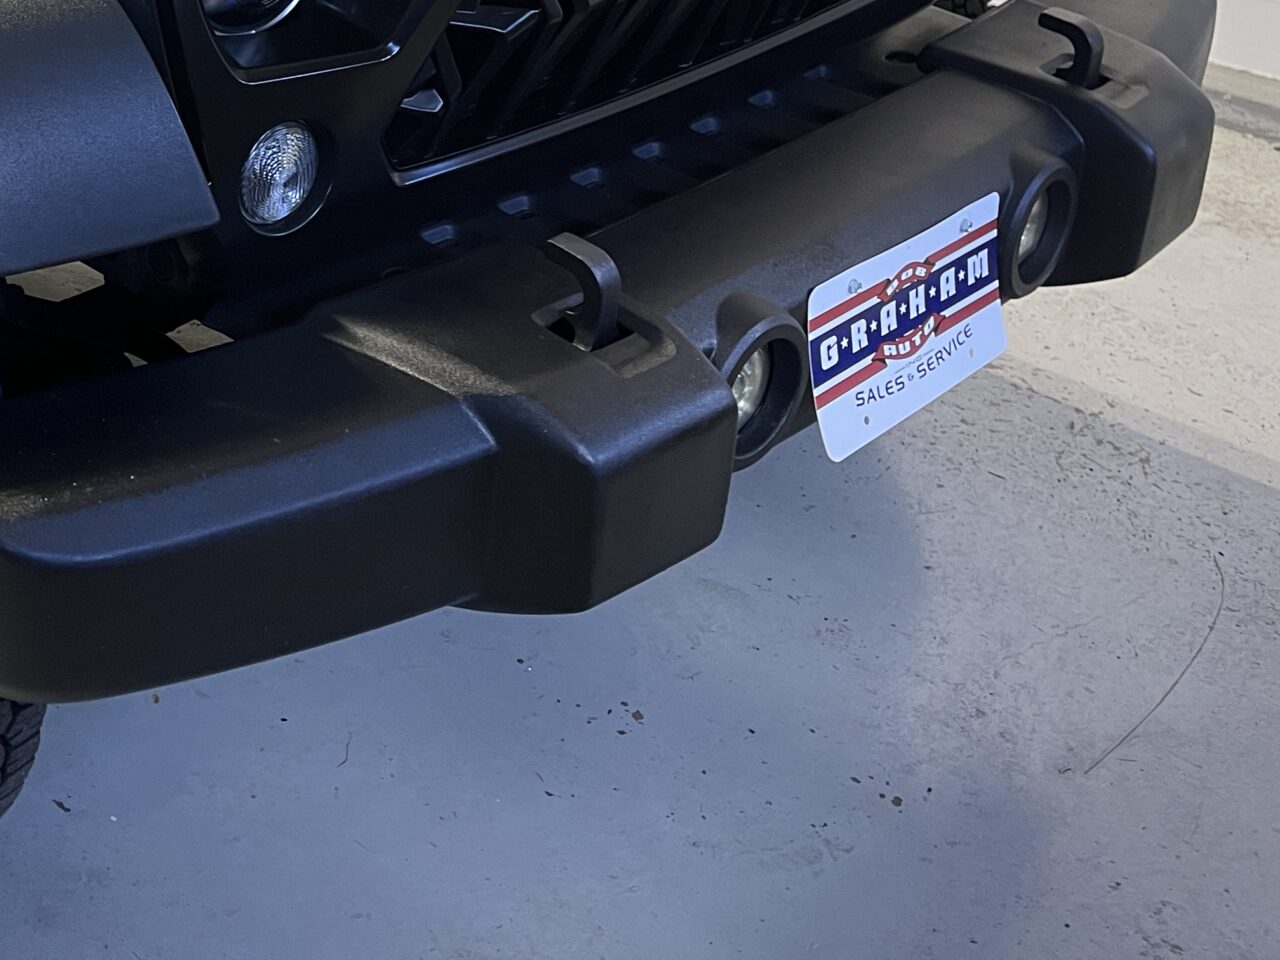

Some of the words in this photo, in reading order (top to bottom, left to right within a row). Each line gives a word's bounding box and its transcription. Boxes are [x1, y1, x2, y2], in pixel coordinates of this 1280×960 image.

[855, 375, 905, 407] SALES
[916, 323, 974, 379] SERVICE
[882, 315, 935, 357] AUTO
